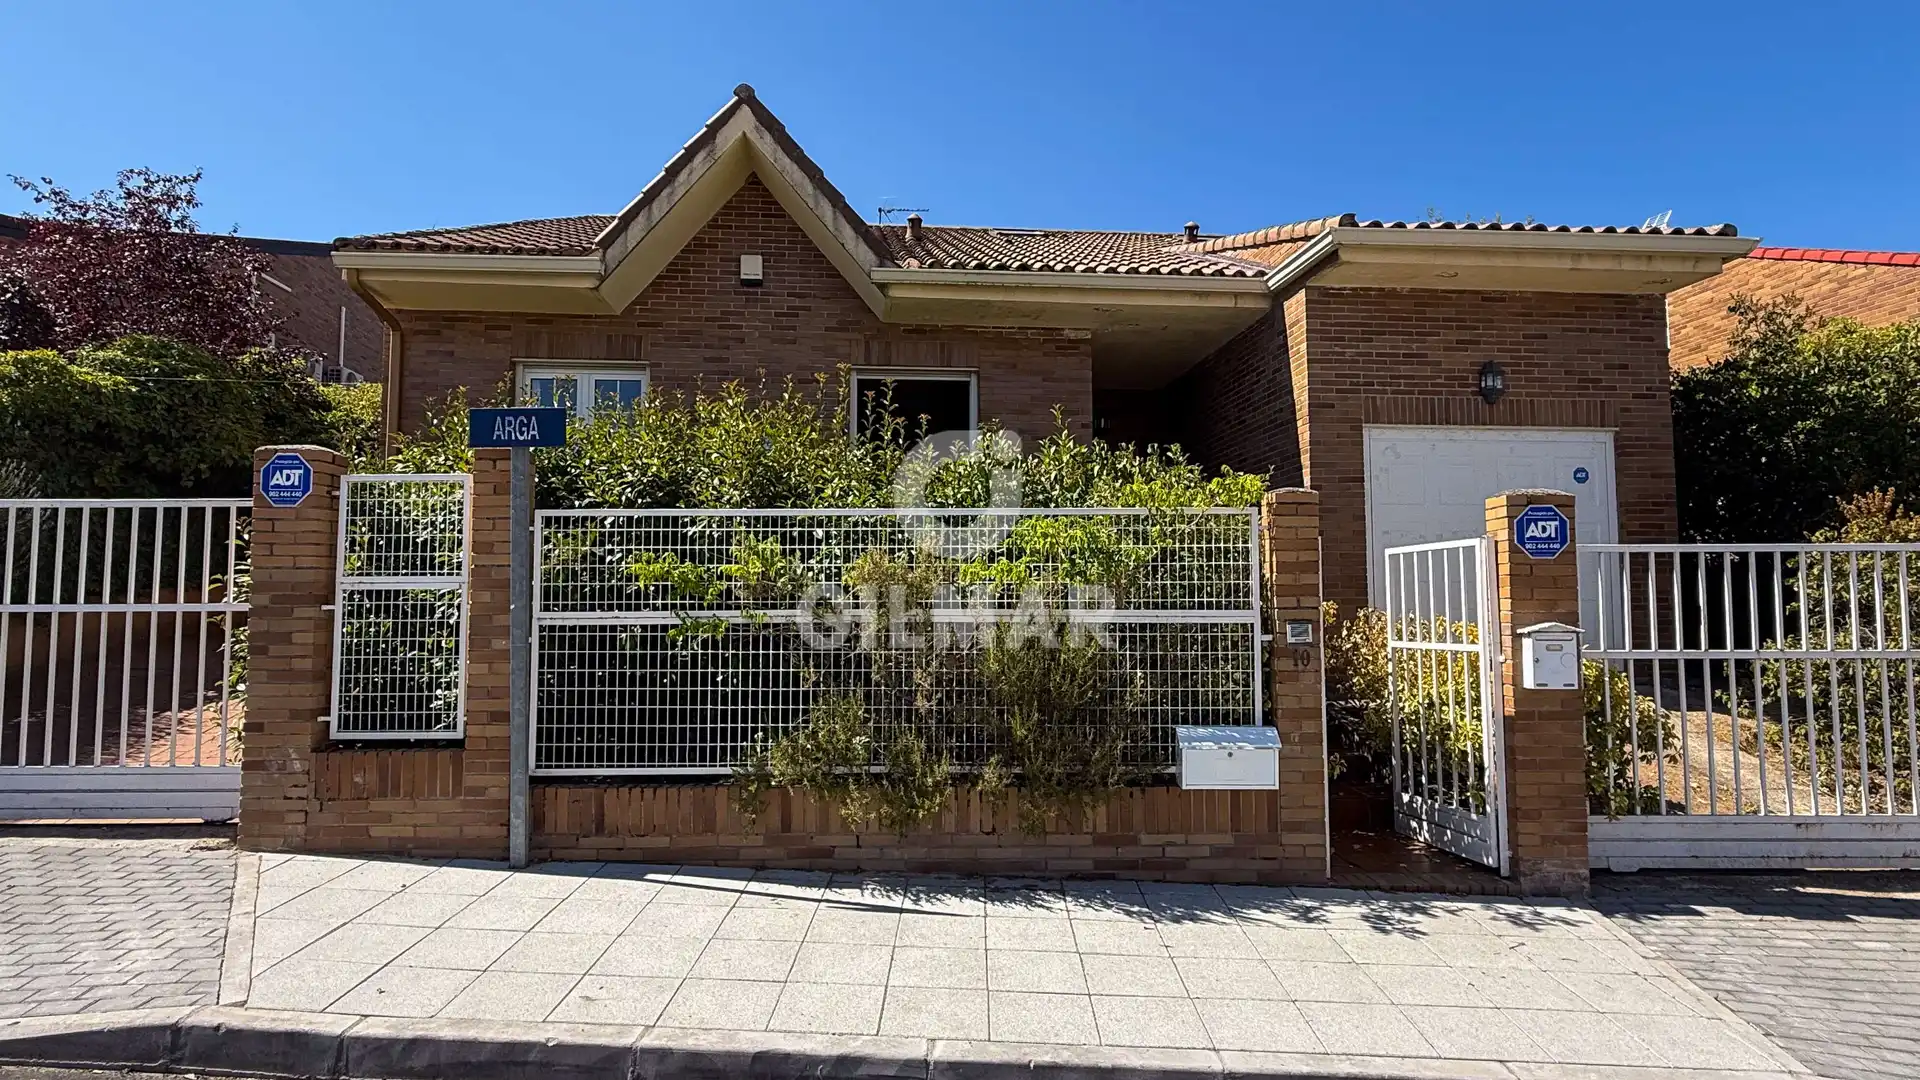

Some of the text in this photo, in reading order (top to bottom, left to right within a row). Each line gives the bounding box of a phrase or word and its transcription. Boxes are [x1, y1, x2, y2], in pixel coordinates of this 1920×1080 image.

[493, 416, 539, 440] ARGA
[270, 469, 304, 486] ADT
[1525, 521, 1559, 538] ADT
[1292, 649, 1311, 667] 10
